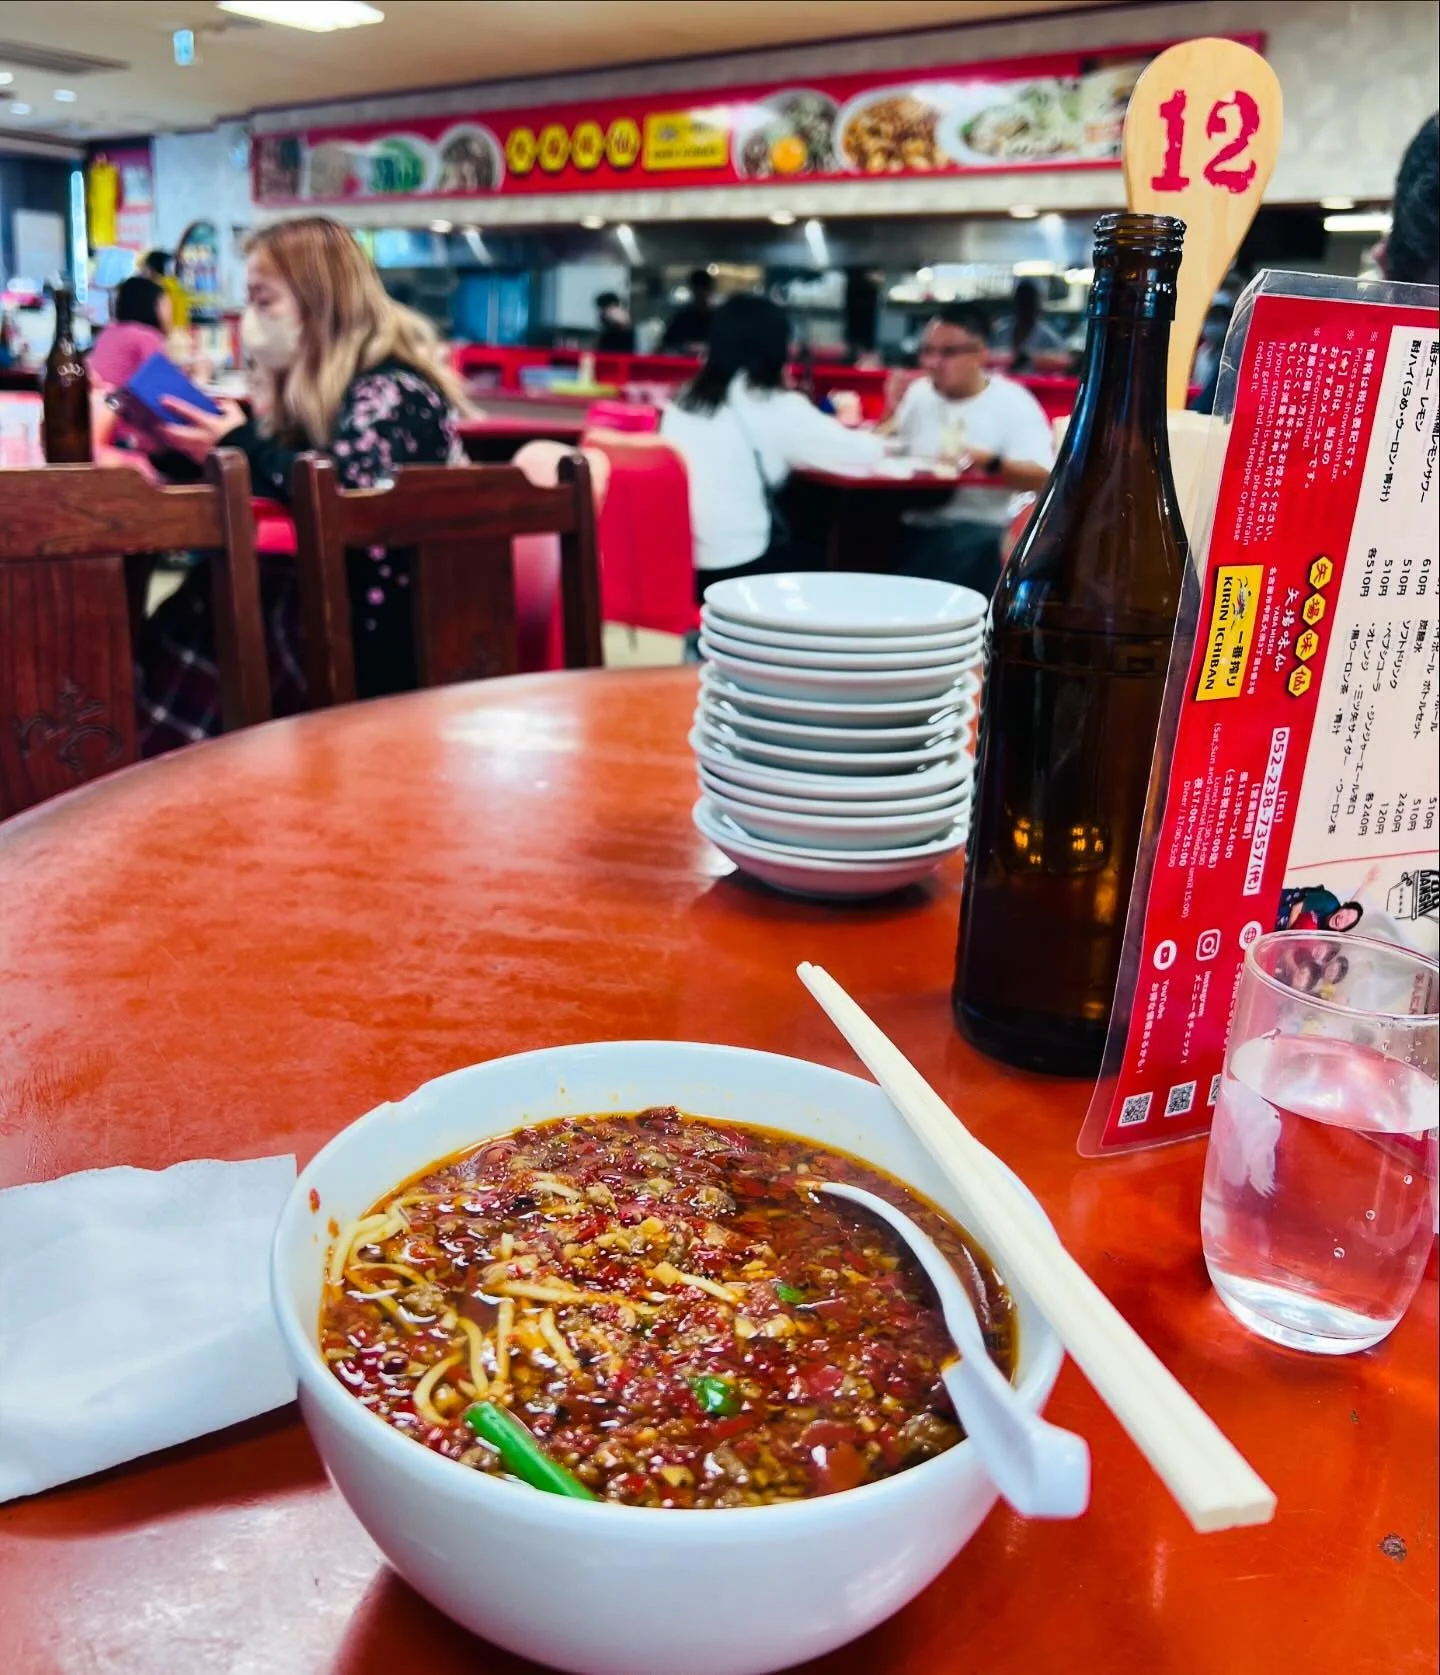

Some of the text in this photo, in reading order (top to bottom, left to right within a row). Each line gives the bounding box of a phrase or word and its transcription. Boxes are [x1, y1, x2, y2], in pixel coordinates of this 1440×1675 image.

[1151, 89, 1260, 193] 12
[1250, 341, 1264, 392] reduce it.
[1274, 352, 1282, 377] your
[1261, 379, 1278, 426] stomach
[1302, 358, 1325, 449] is recommended.
[1304, 346, 1339, 488] おすすめメニューです。
[1331, 347, 1363, 479] Prices are shown with tax.
[1415, 396, 1428, 431] レモン
[1233, 341, 1276, 540] from garlic and red pepper. Or please
[1263, 429, 1271, 438] is
[1254, 440, 1267, 471] weak,
[1249, 474, 1260, 508] please
[1242, 510, 1253, 545] refrain
[1359, 547, 1377, 596] 各510円
[1377, 559, 1393, 596] 510円
[1396, 559, 1412, 595] 510円
[1415, 558, 1431, 595] 610円
[1204, 576, 1232, 689] KIRIN ICHIBAN
[1266, 605, 1280, 654] YABA MISEN
[1274, 587, 1299, 671] 矢場味仙
[1290, 563, 1328, 693] 矢場味仙
[1226, 630, 1243, 686] 一番搾り
[1358, 620, 1410, 835] ソフトドリンク 各240円
[1374, 619, 1428, 834] 炭酸水 120円
[1181, 780, 1191, 806] Diner
[1206, 766, 1214, 784] and
[1210, 776, 1221, 805] Lunch
[1198, 786, 1211, 825] national
[1391, 792, 1407, 832] 2420円
[1407, 798, 1421, 831] 510円
[1422, 797, 1437, 829] 510円
[1190, 826, 1205, 865] holidays
[1186, 866, 1194, 888] until
[1156, 978, 1169, 1019] YouTube
[1197, 970, 1211, 1016] Instagram
